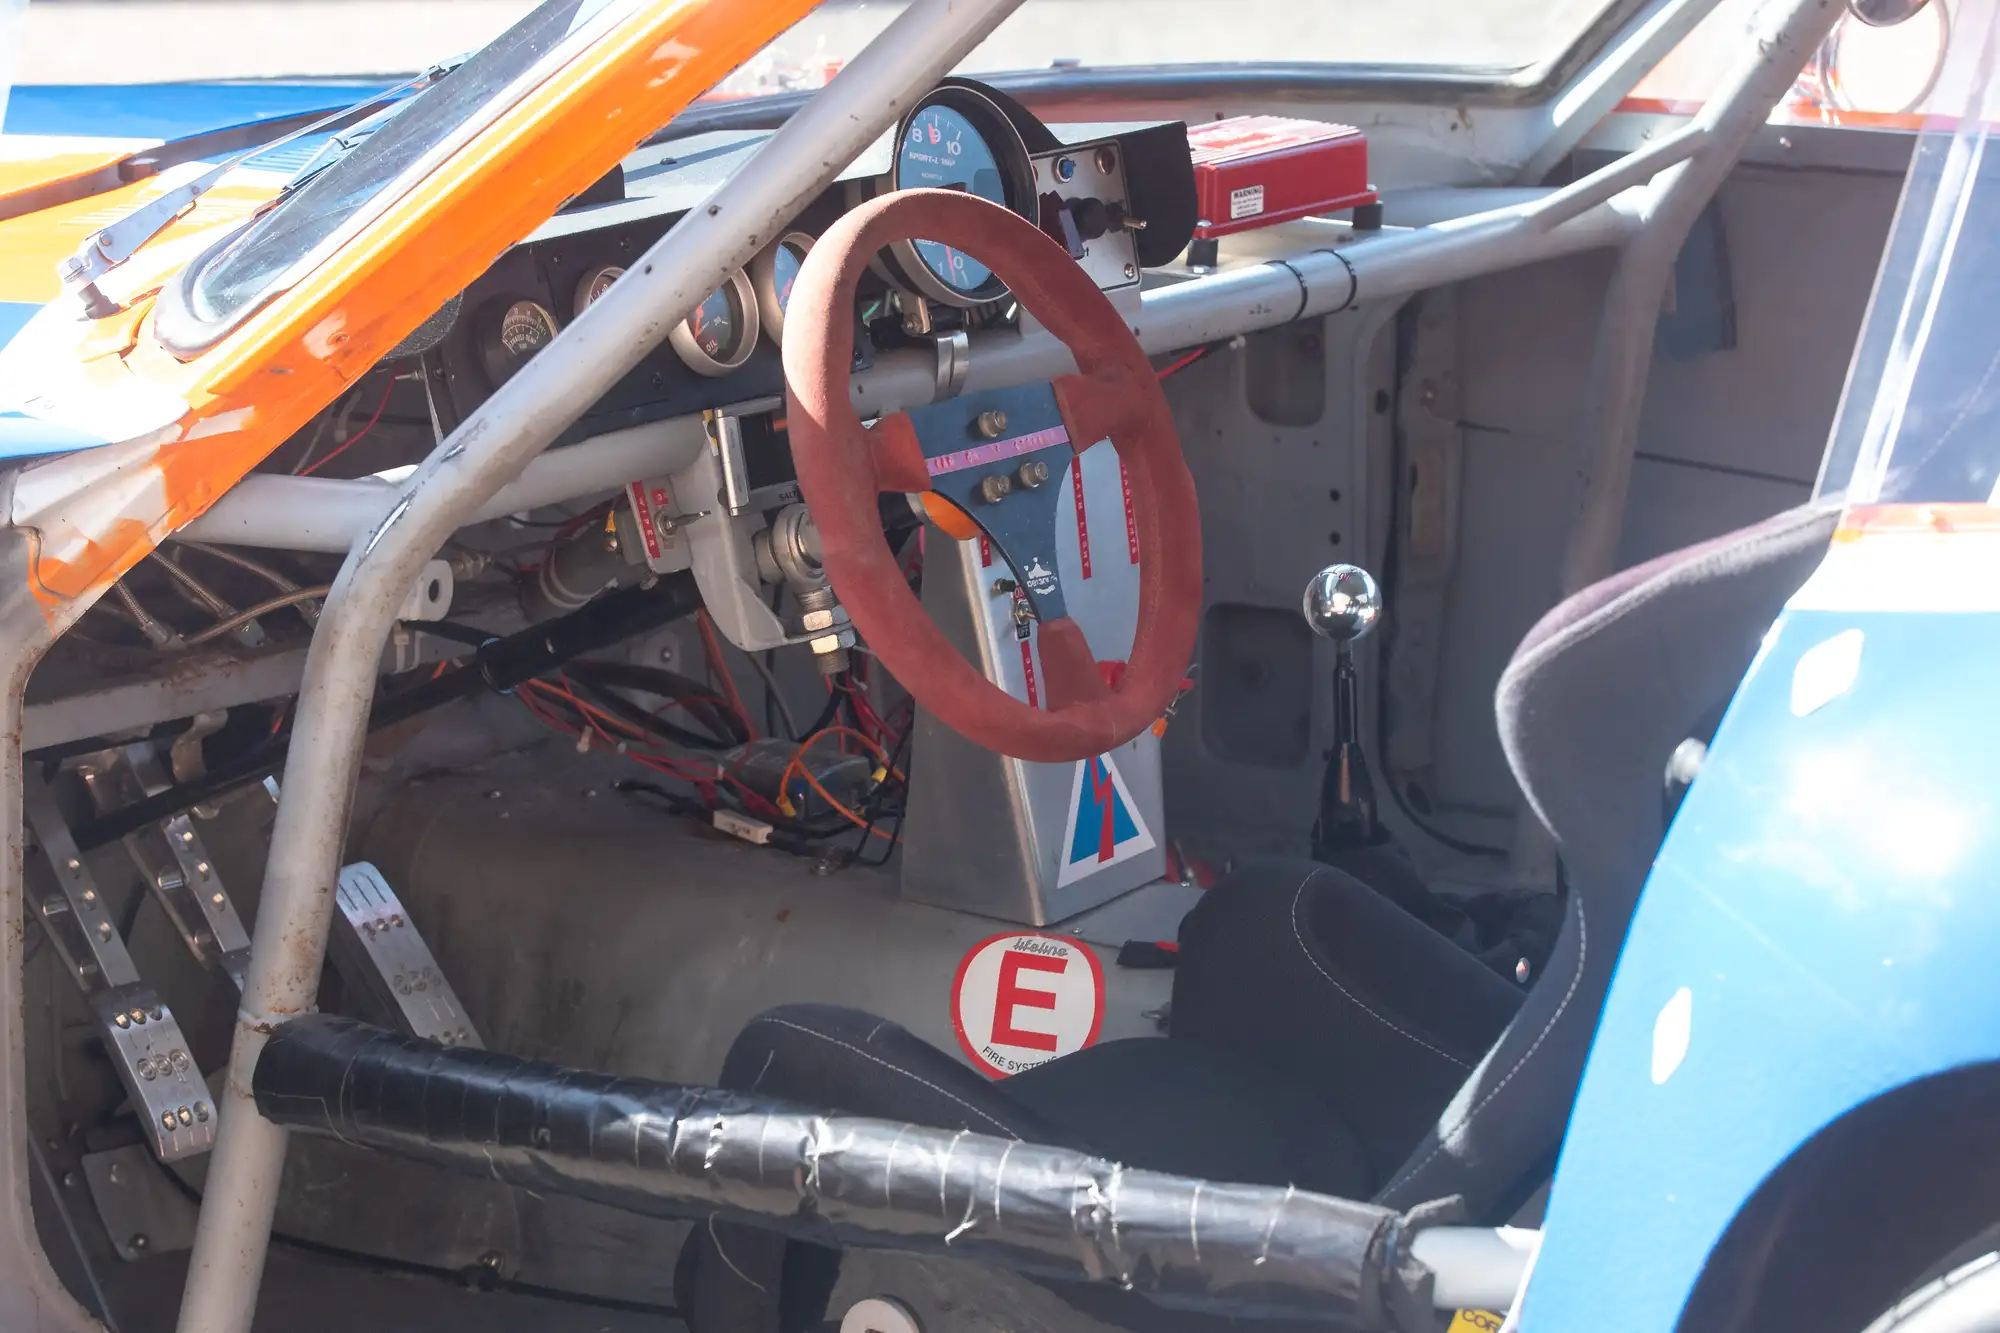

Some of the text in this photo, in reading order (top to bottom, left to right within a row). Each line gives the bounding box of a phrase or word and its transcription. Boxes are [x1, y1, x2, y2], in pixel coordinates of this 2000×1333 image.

[912, 128, 923, 143] 8
[946, 141, 962, 156] 10
[638, 495, 656, 548] WIPER
[1121, 463, 1138, 555] EADLIGHTS
[990, 949, 1069, 1053] E
[982, 1045, 1058, 1072] FIRE SYST
